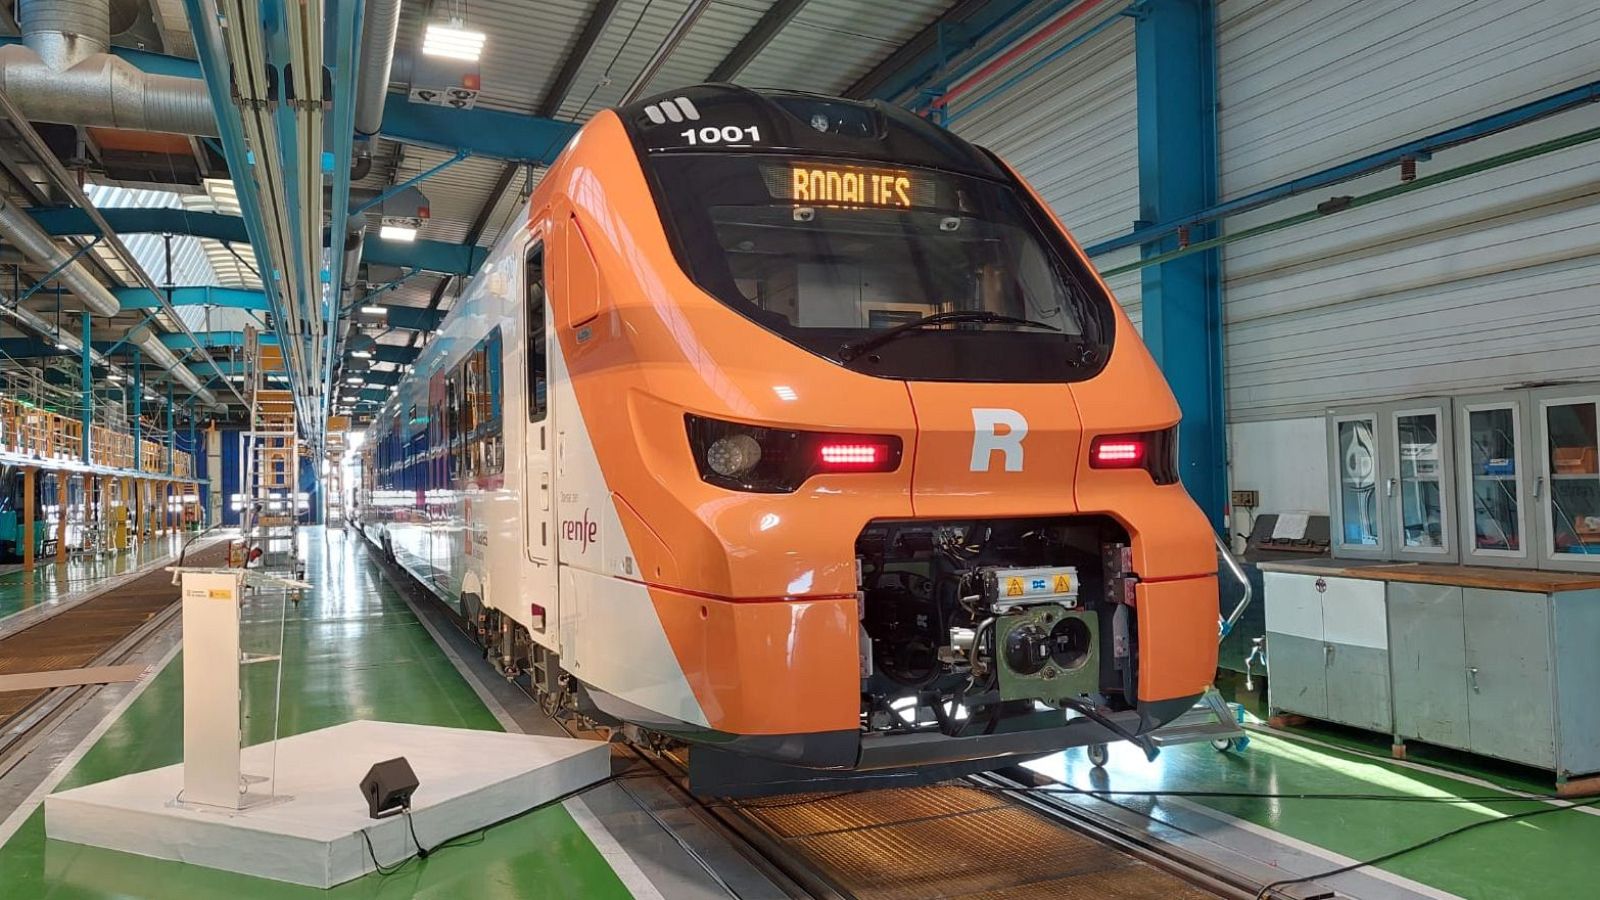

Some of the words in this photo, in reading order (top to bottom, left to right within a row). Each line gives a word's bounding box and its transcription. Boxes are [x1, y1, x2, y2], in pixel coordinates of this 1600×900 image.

[680, 125, 760, 145] 1001
[969, 407, 1029, 472] R
[562, 507, 598, 554] renfe
[1032, 579, 1046, 589] DC
